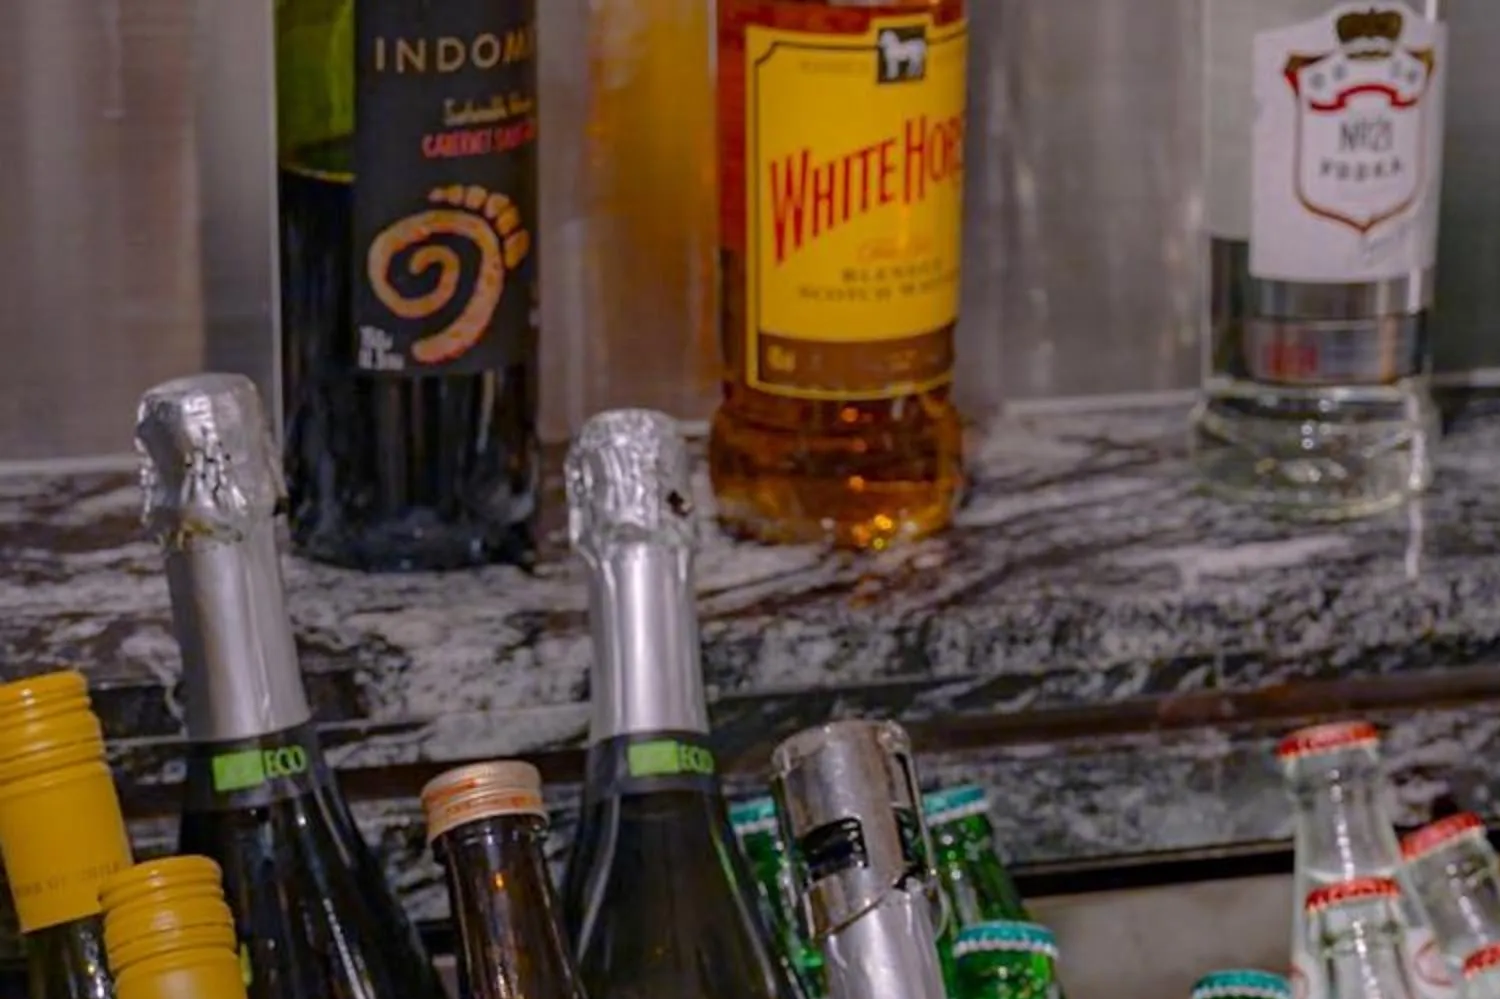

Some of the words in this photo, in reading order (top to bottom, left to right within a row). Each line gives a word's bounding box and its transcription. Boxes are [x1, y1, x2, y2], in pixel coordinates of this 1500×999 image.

[374, 31, 535, 73] INDOM
[769, 137, 898, 267] WHITE
[263, 745, 307, 779] ECO
